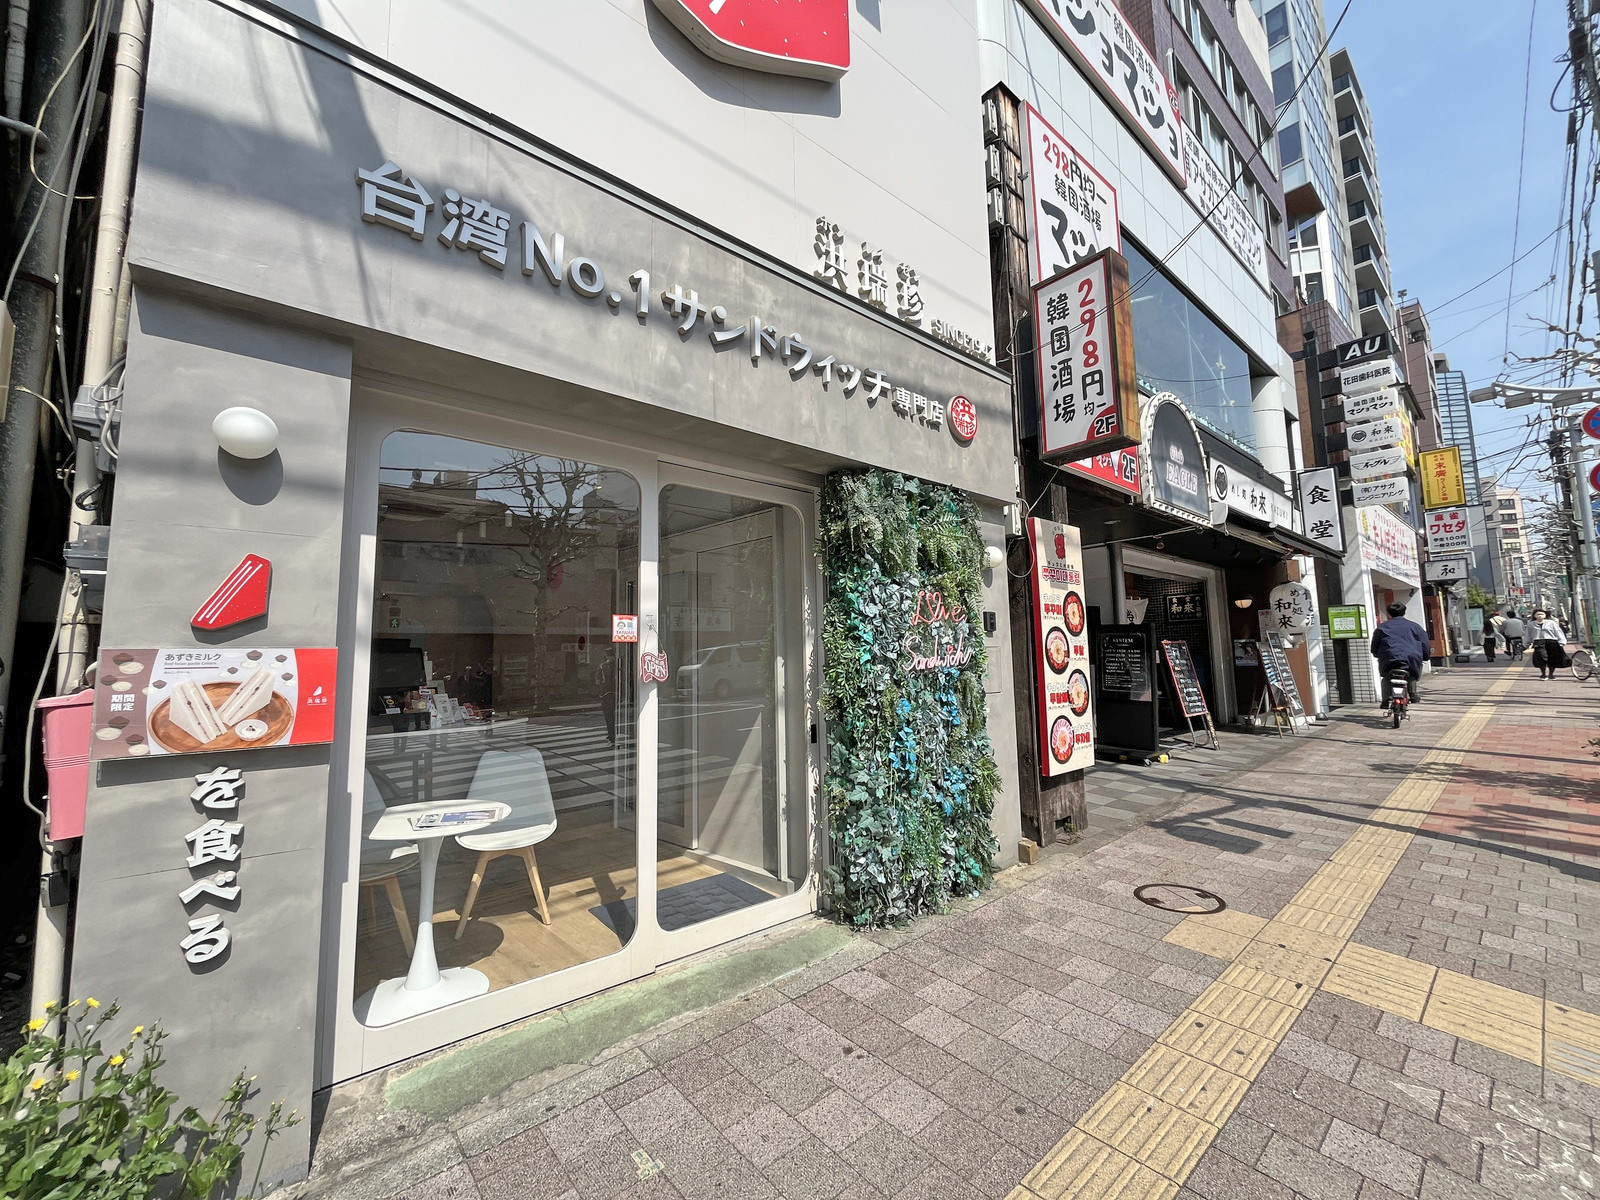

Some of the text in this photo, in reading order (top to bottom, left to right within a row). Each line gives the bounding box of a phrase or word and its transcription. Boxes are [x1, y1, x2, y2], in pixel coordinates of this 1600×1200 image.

[1042, 133, 1108, 206] 298円均一
[1054, 173, 1102, 232] 韓国酒場
[1046, 292, 1077, 424] 韓国酒場
[1345, 336, 1381, 360] AU
[1343, 366, 1391, 386] 花田歯科医院
[1095, 416, 1117, 437] 2F
[1121, 452, 1137, 484] 2F
[1166, 461, 1198, 495] EAGLE
[1356, 489, 1405, 502] エンジニアリング
[1306, 485, 1335, 540] 食堂
[1429, 520, 1466, 535] ワセダ
[1290, 588, 1304, 616] めし処
[165, 653, 222, 661] あずきミルク
[644, 660, 667, 678] OPEN
[110, 702, 135, 712] 限定
[111, 694, 136, 703] 期間
[179, 766, 246, 964] を食べる
